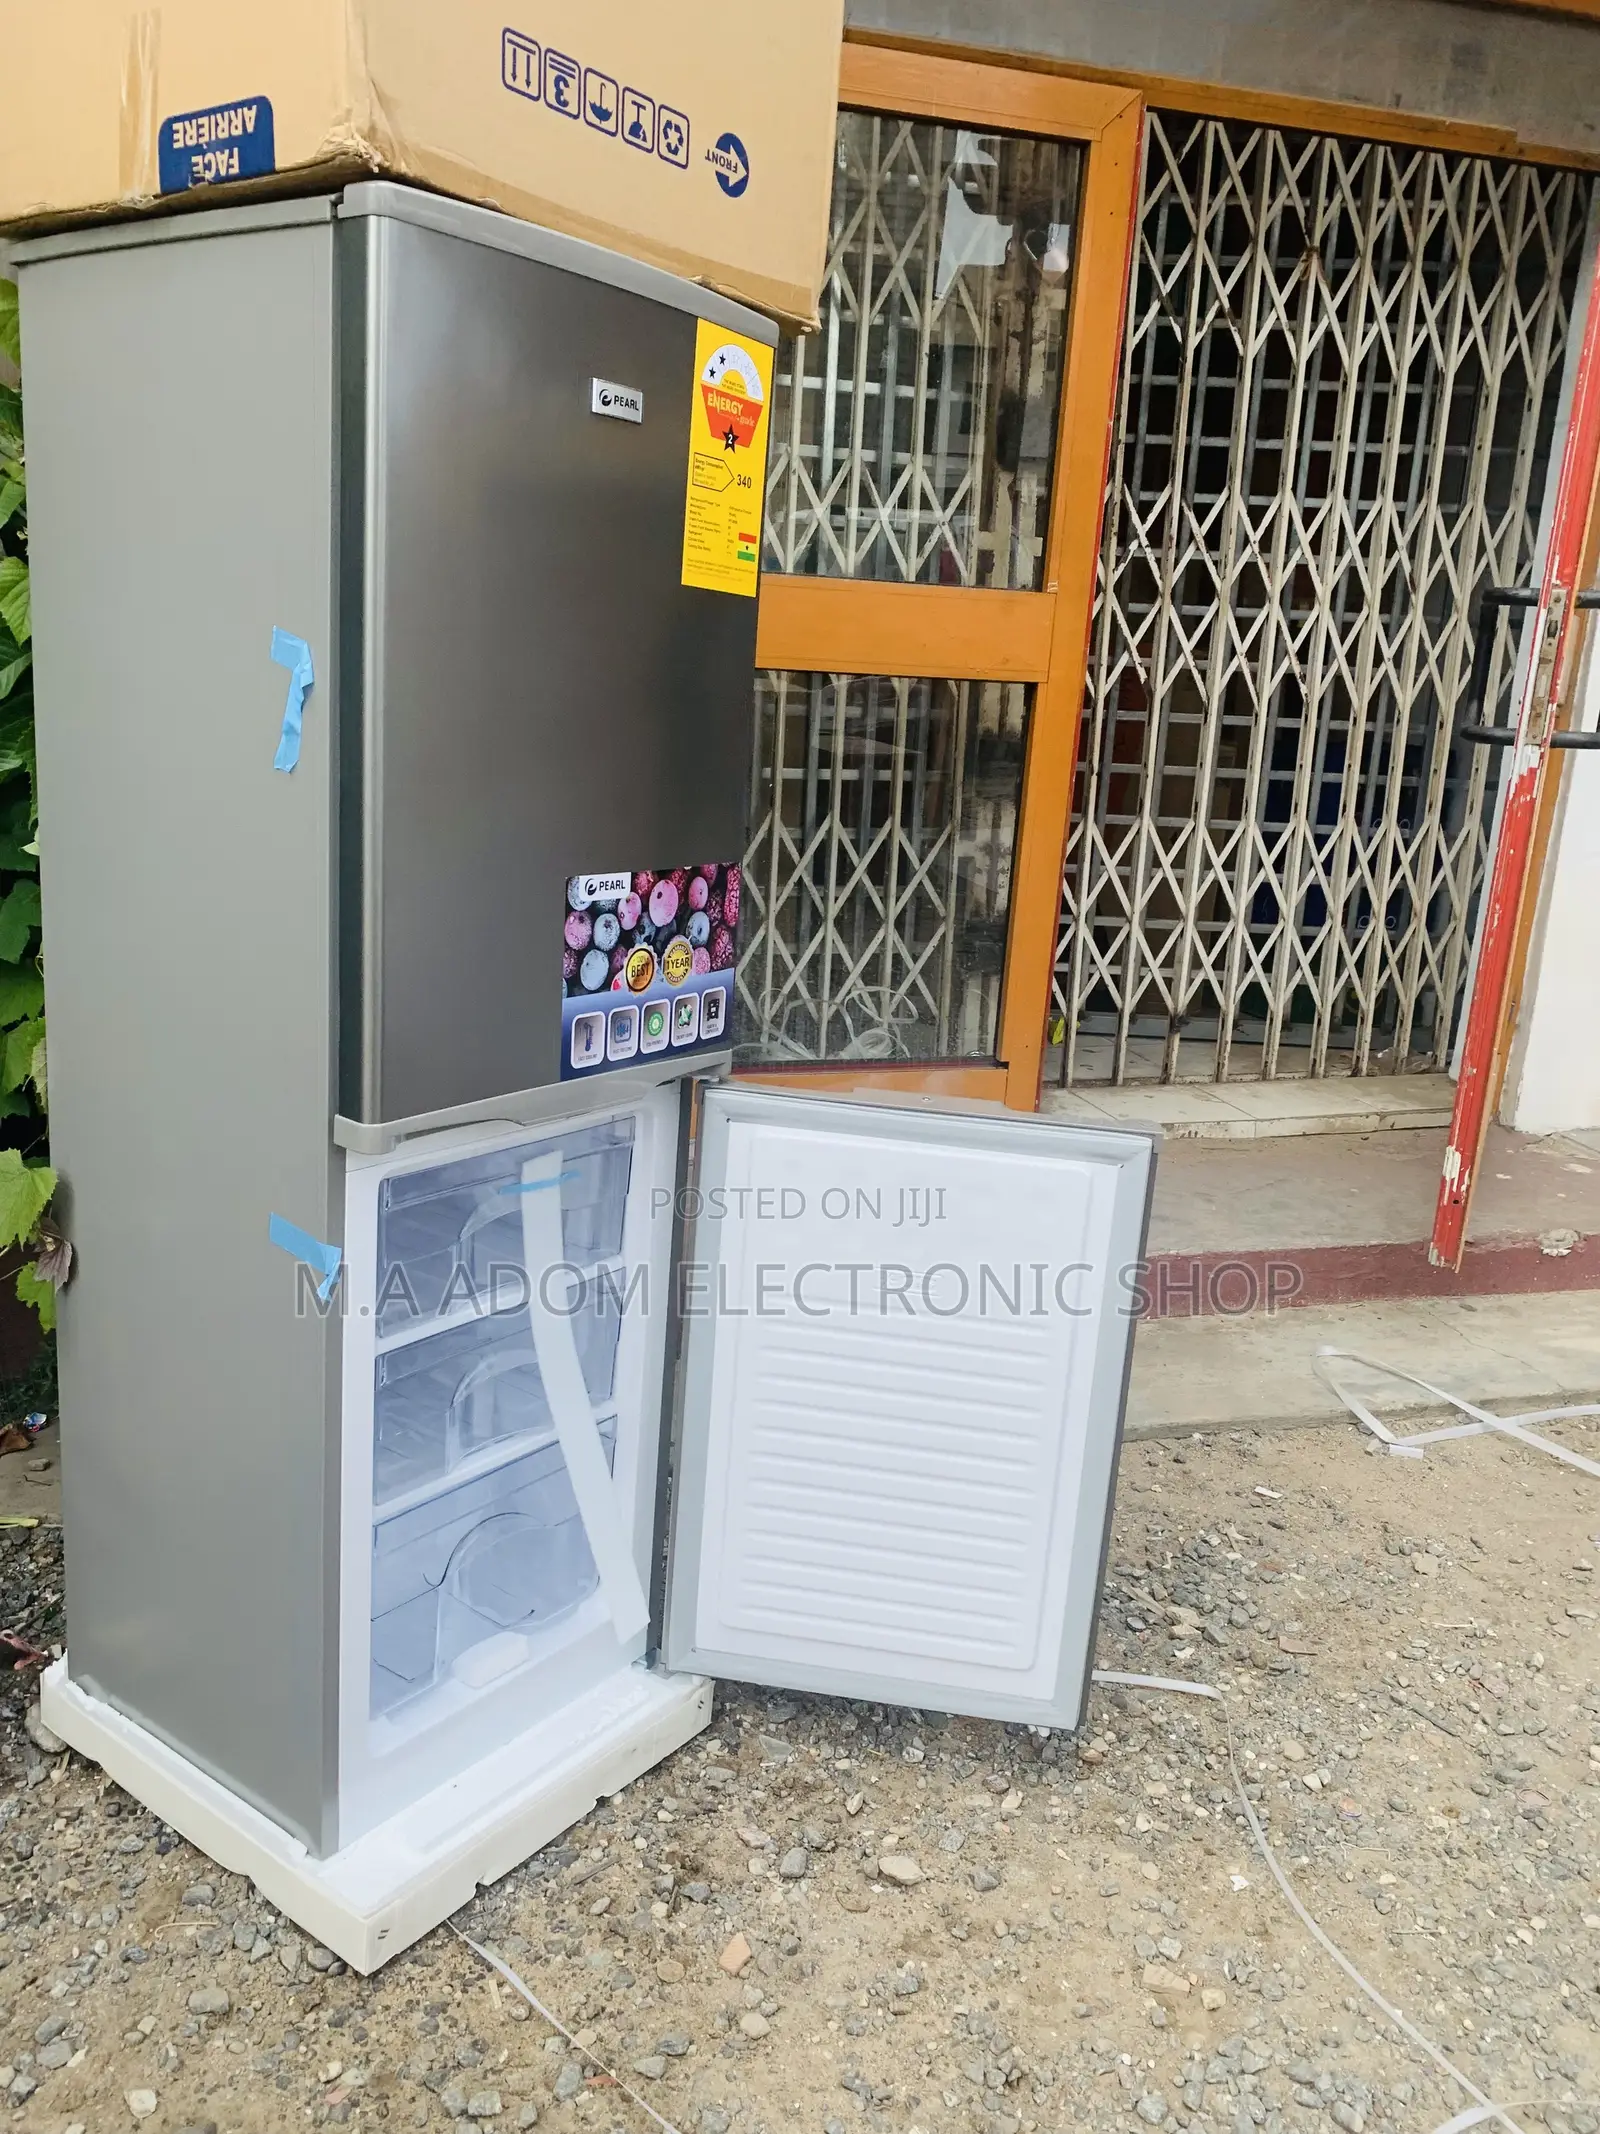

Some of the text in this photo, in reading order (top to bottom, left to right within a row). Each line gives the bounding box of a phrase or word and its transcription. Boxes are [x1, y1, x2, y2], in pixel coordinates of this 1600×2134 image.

[172, 105, 257, 149] ARRIÈRE
[191, 147, 240, 181] FACE
[704, 149, 739, 174] FRONT
[613, 395, 640, 411] PEARL
[708, 390, 743, 416] ENERGY
[728, 433, 733, 445] 2
[737, 473, 752, 489] 340
[599, 879, 626, 892] PEARL
[631, 961, 650, 978] BEST
[671, 957, 690, 969] YEAR
